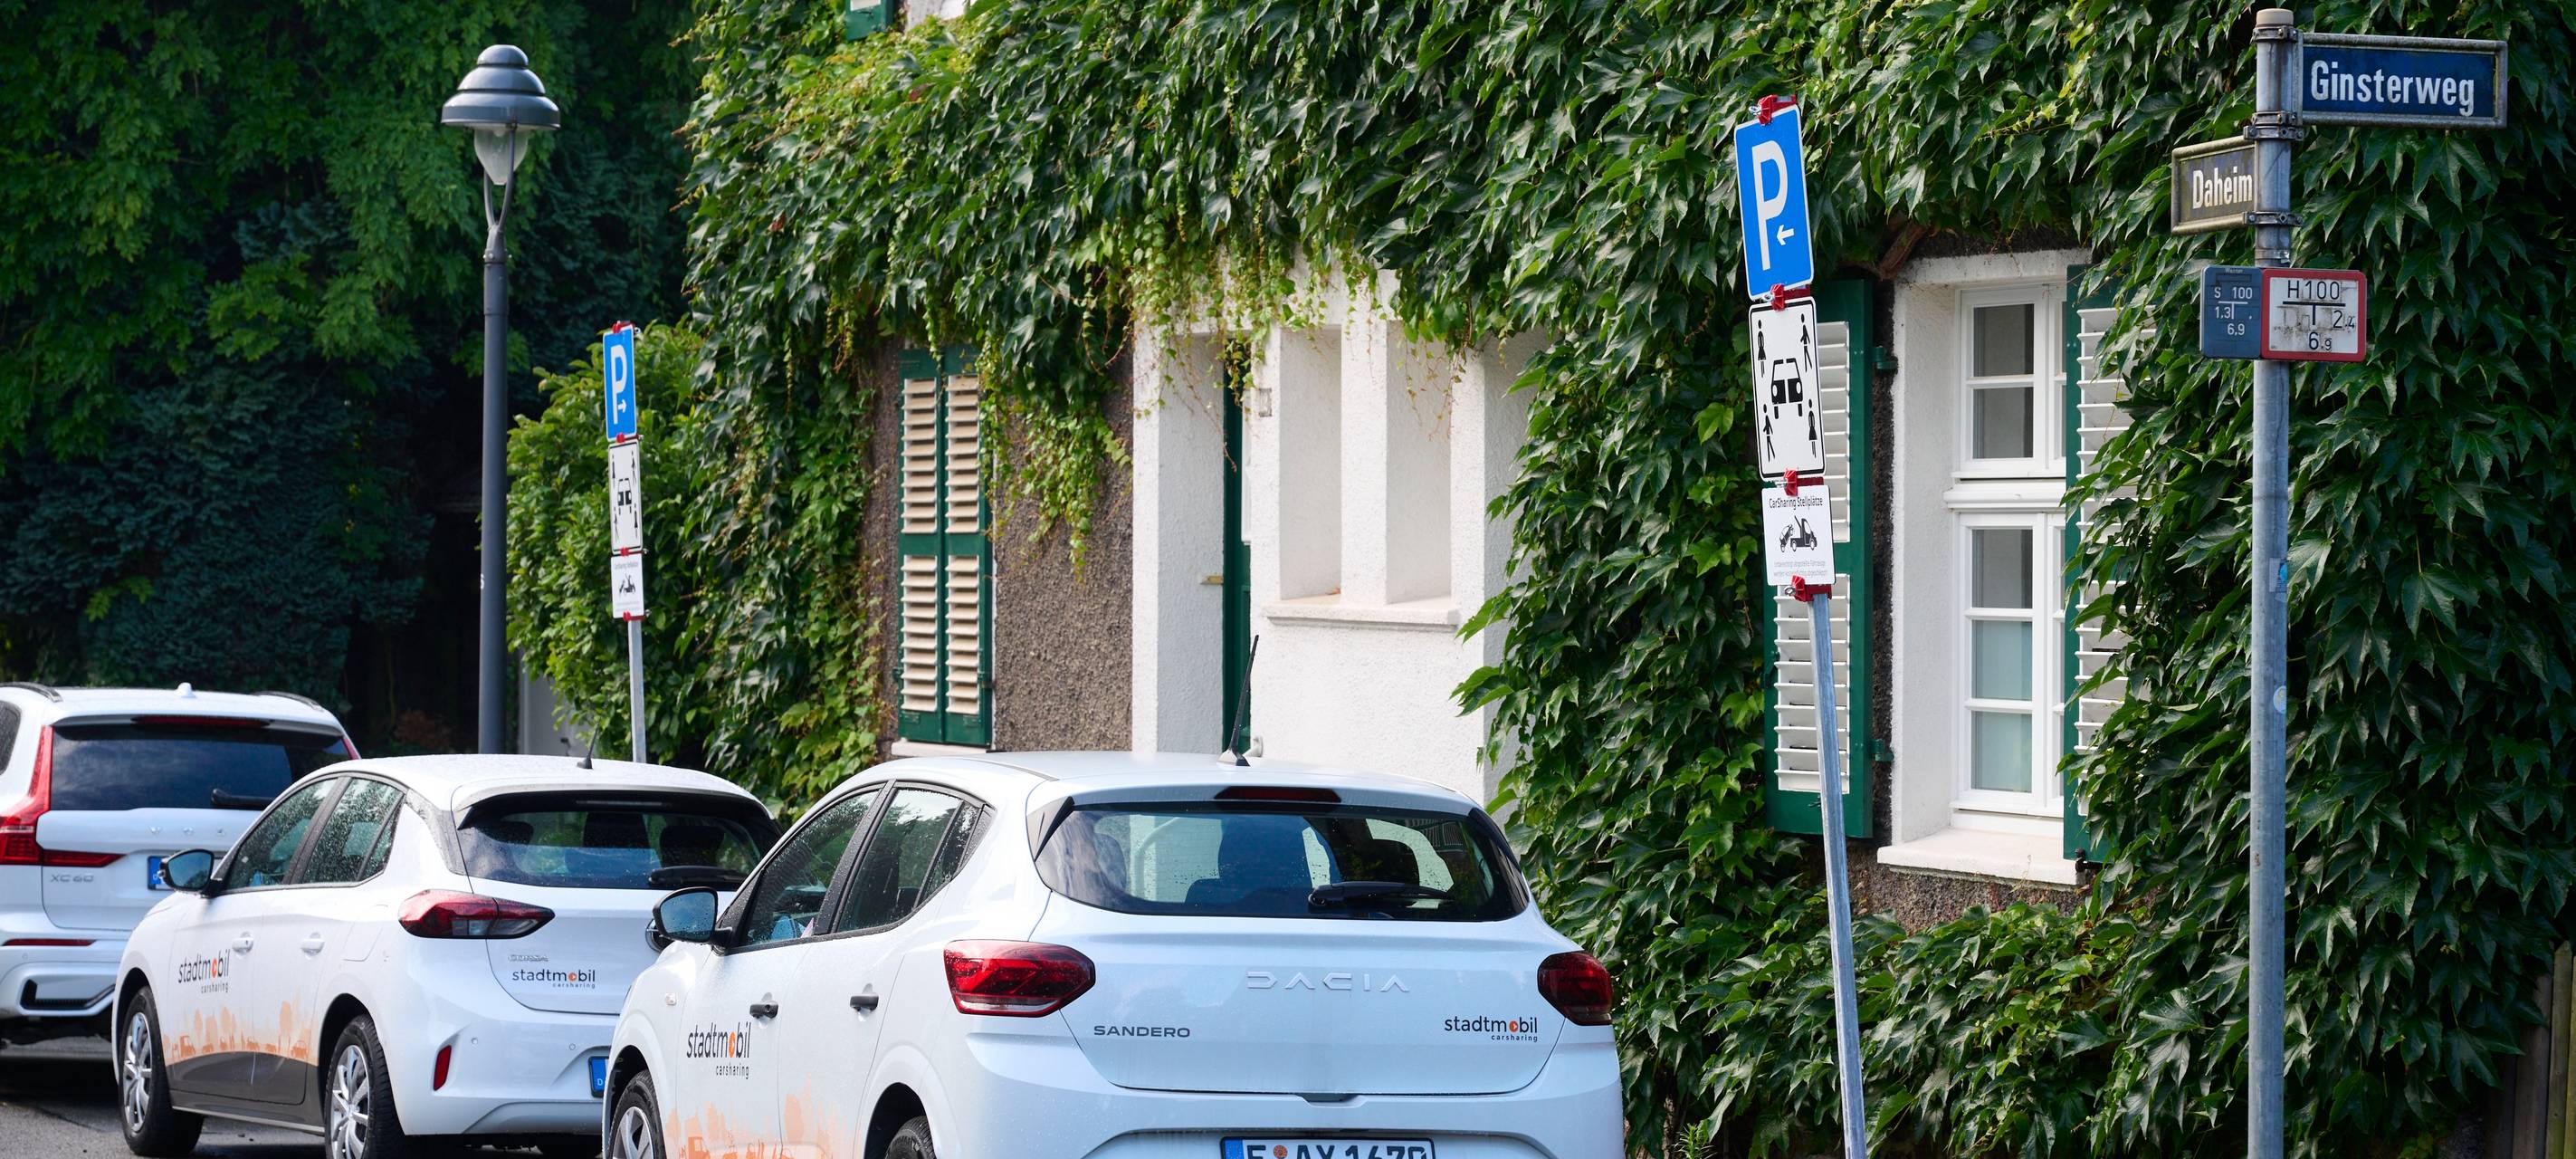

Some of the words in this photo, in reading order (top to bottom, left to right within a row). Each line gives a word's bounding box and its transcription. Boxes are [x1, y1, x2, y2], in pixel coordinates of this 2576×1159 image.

[2311, 60, 2475, 117] Ginsterweg
[2191, 166, 2253, 209] Daheim
[1751, 140, 1789, 271] P
[2214, 286, 2221, 299] S
[2232, 286, 2253, 299] 100
[2287, 280, 2340, 300] H100
[2215, 306, 2231, 319] 1,3
[2227, 323, 2245, 336] 6,9
[610, 344, 627, 425] P
[178, 948, 230, 984] stadtmobil
[511, 968, 596, 982] stadtmobil
[1246, 971, 1410, 992] DACIA
[1092, 1024, 1191, 1038] SANDERO
[1444, 1015, 1538, 1033] stadtmobil
[686, 1020, 751, 1058] stadtmobil
[1491, 1034, 1538, 1042] carsharing
[716, 1061, 749, 1080] carsharing
[597, 1078, 604, 1087] D
